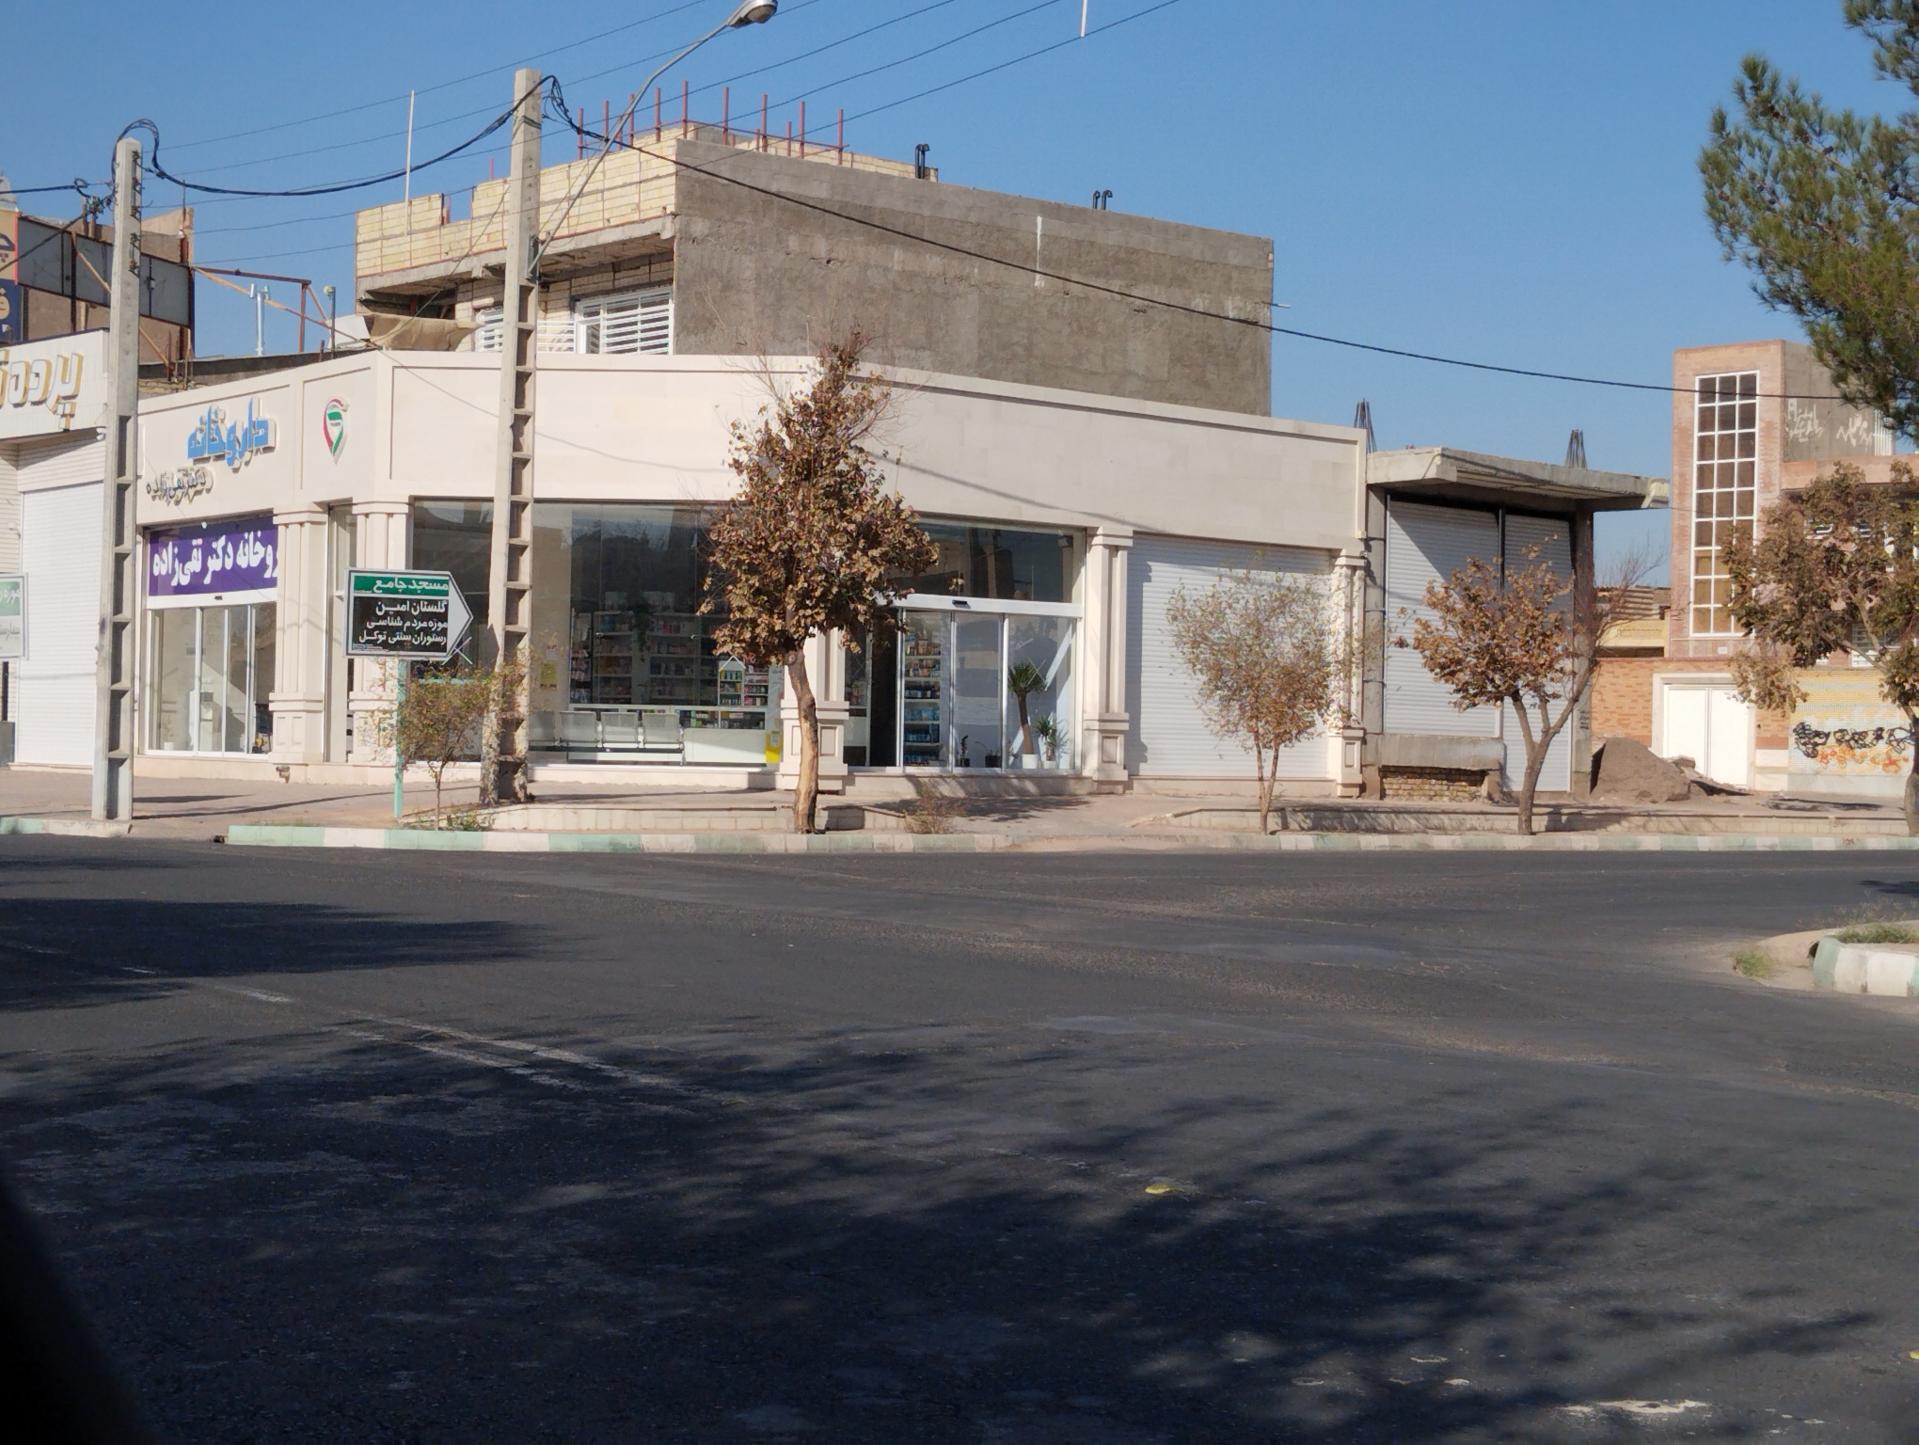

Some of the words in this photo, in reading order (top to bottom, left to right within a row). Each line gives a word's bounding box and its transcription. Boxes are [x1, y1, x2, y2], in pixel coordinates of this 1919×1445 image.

[186, 397, 272, 469] داروخانه
[203, 534, 234, 584] دکتر
[372, 577, 407, 593] جامع
[407, 579, 448, 594] مسجد
[375, 600, 410, 616] امین
[411, 600, 447, 616] گلستان
[366, 616, 403, 630] شناسی
[428, 619, 449, 631] موزه
[359, 629, 388, 644] توکل
[388, 631, 412, 644] سنتی
[412, 632, 447, 646] رستوران
